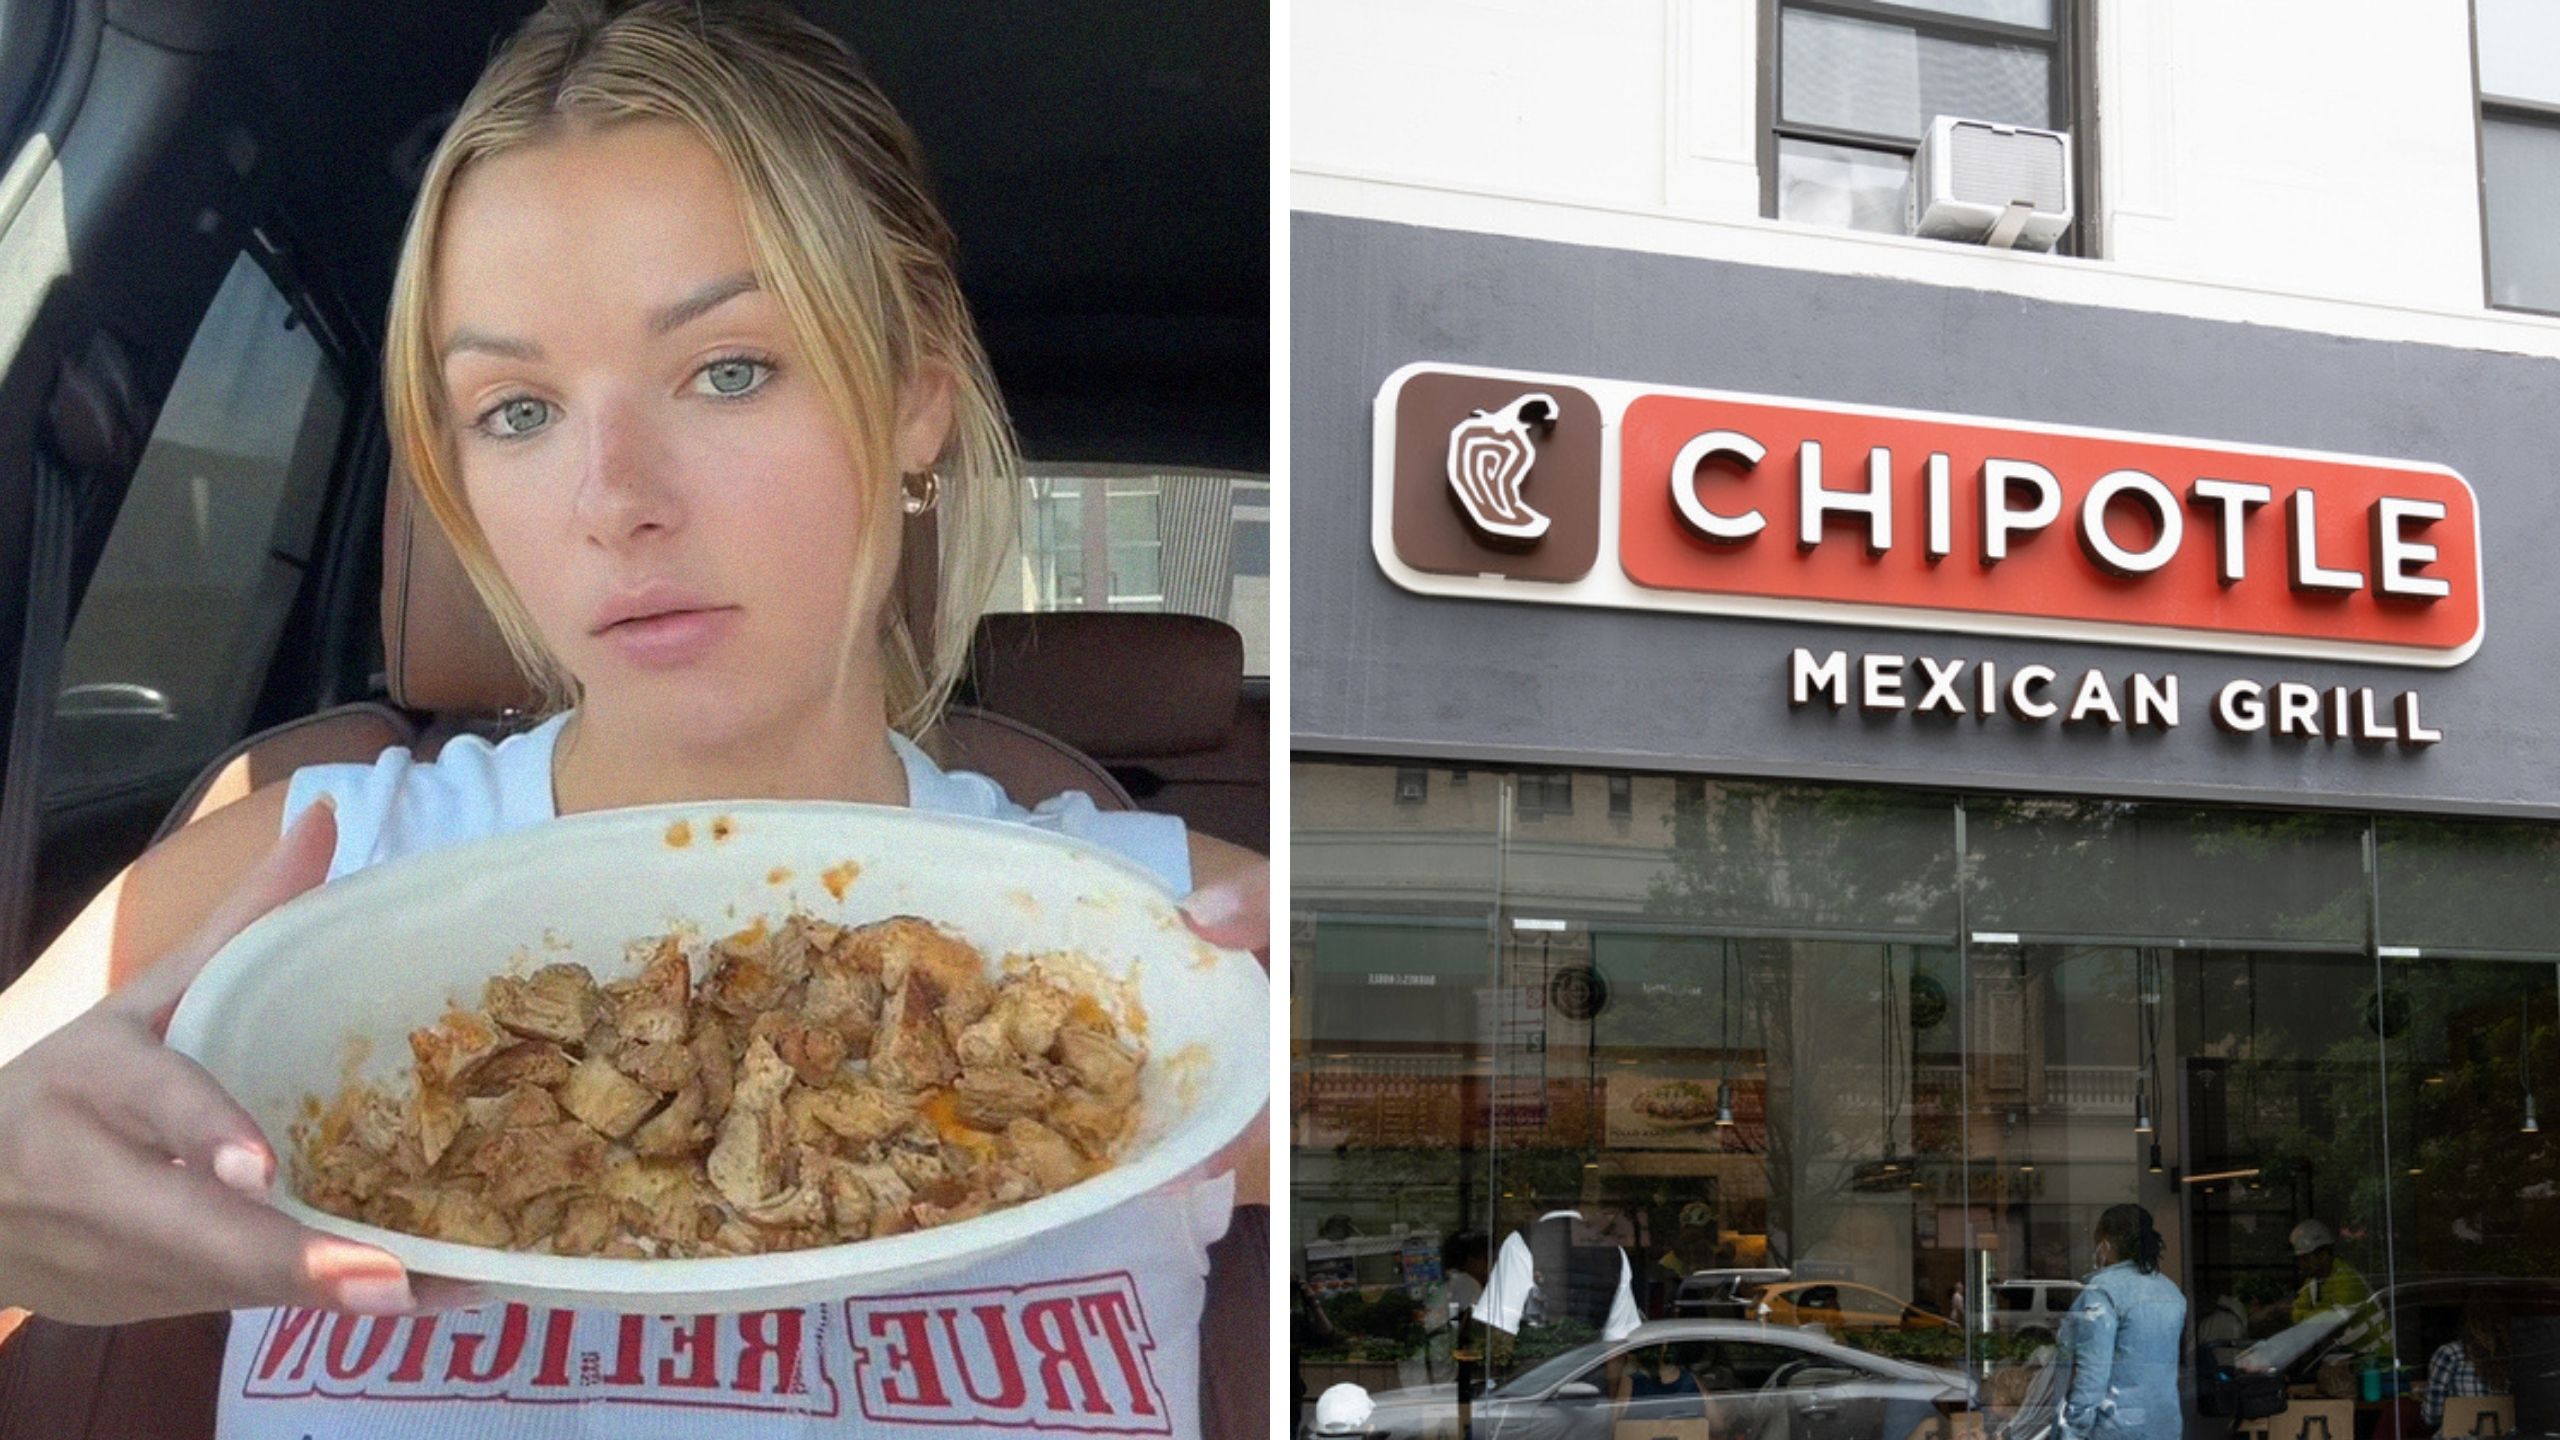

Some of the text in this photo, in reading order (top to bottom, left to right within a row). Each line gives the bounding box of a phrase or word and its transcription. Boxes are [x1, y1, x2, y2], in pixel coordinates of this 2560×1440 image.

[1669, 429, 2451, 602] CHIPOTLE
[1791, 646, 2443, 746] MEXICAN GRILL
